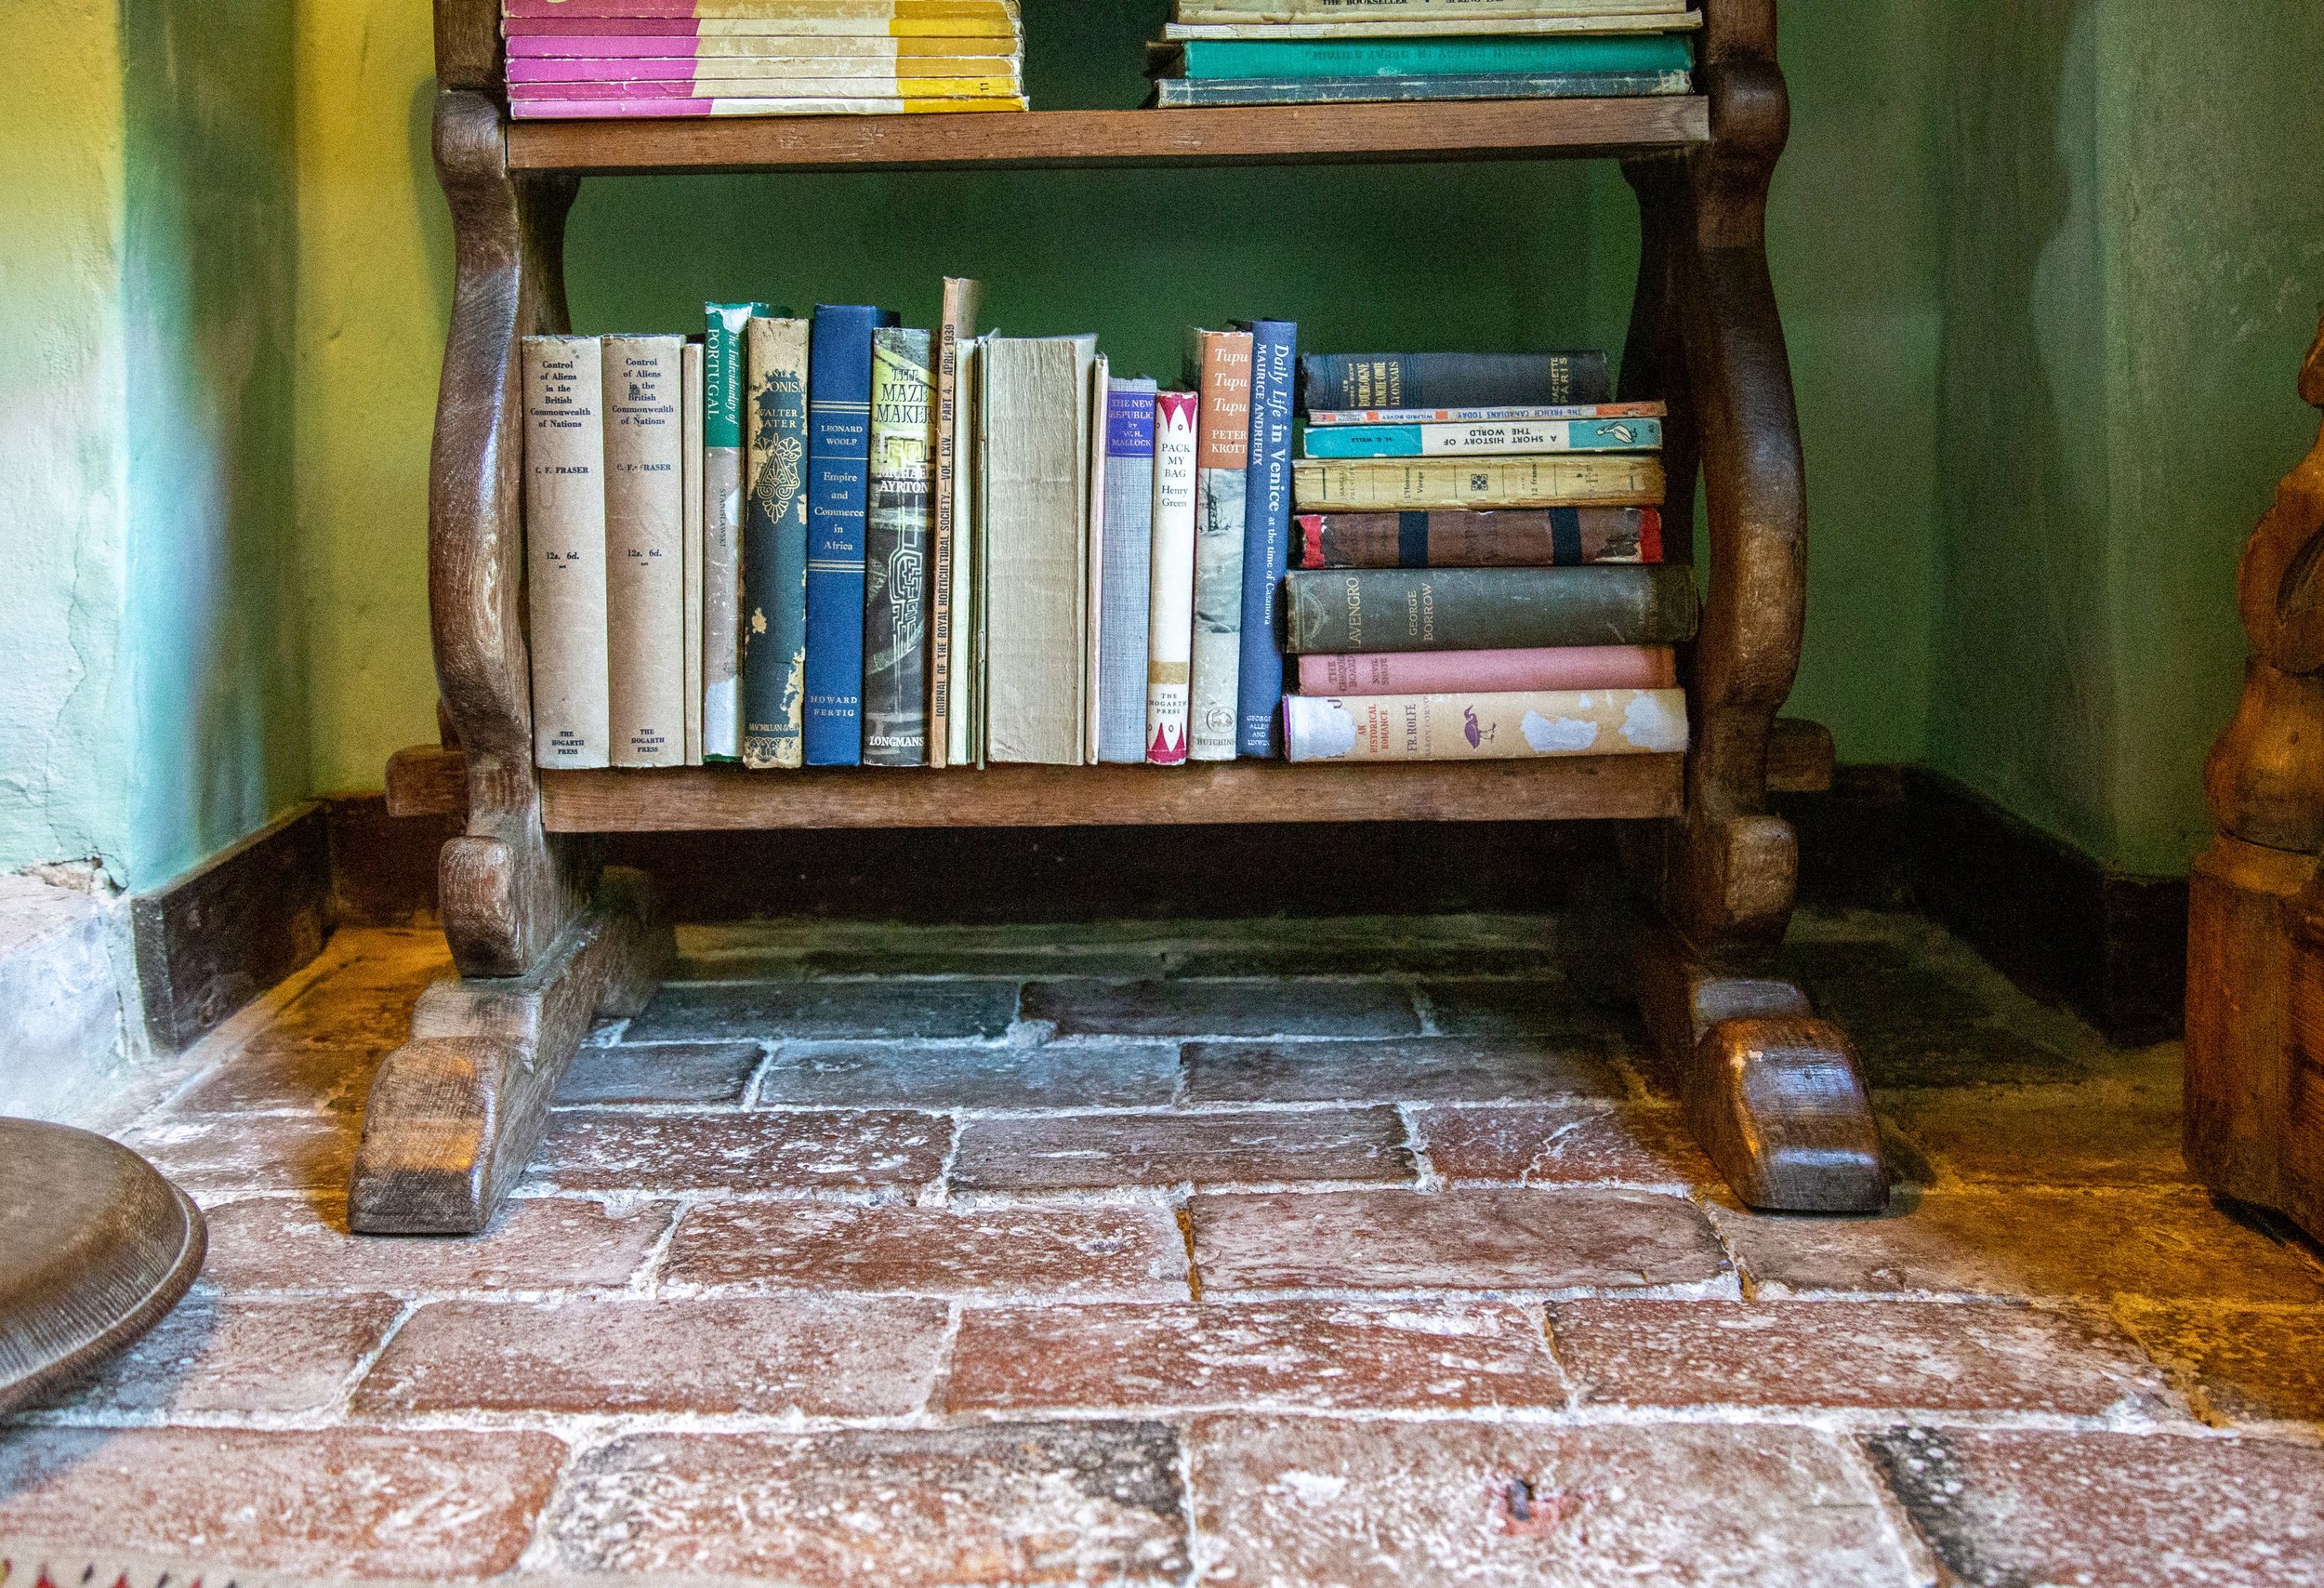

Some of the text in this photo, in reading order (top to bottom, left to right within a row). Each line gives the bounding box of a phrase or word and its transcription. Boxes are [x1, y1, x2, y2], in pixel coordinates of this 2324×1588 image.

[980, 83, 989, 91] 11
[944, 324, 955, 347] 1939
[626, 358, 657, 366] Control
[1214, 348, 1248, 366] Tupu
[542, 361, 574, 369] Control
[943, 351, 954, 376] APRIL
[552, 373, 577, 381] Aliens
[636, 369, 661, 378] Aliens
[707, 328, 720, 419] PORTUGAL
[726, 333, 740, 425] he Individuality of
[891, 368, 919, 381] THE
[1214, 372, 1248, 391] Tupu
[1356, 363, 1371, 407] BOURGOGNE
[1388, 361, 1400, 406] LYONNAIS
[1550, 357, 1559, 403] HACHETTE
[1559, 357, 1569, 404] PARIS
[628, 393, 656, 402] British
[880, 383, 929, 403] MAZE
[545, 396, 573, 404] British
[1112, 399, 1154, 408] THE NEW
[1252, 343, 1267, 466] MAURICE ANDRIEUX
[530, 407, 591, 417] Commonwealth
[612, 404, 674, 414] Commonwealth
[942, 397, 953, 422] PART
[1213, 397, 1247, 417] Tupu
[875, 404, 936, 424] MAKER
[1487, 409, 1529, 418] CANADIANS
[1535, 409, 1563, 417] FRENCH
[549, 419, 582, 428] Nations
[620, 417, 666, 426] of Nations
[763, 419, 797, 428] ATER
[821, 425, 863, 433] LEONARD
[1212, 430, 1247, 440] PETER
[826, 438, 858, 446] WOOLF
[942, 434, 953, 457] LXIV.
[1162, 443, 1191, 453] PACK
[1211, 443, 1247, 454] KROTT
[1168, 457, 1184, 466] MY
[555, 466, 589, 474] FRASER
[640, 464, 671, 472] RASER
[878, 468, 926, 479] MICHAE
[1165, 469, 1187, 478] BAG
[824, 471, 858, 483] Empire
[878, 480, 929, 494] AYRTON
[1264, 343, 1289, 625] Daily Life in Venice at the time of Casanova
[831, 491, 849, 500] and
[1162, 484, 1188, 496] Henry
[1162, 497, 1187, 508] Green
[814, 507, 865, 517] Commerce
[834, 524, 843, 533] in
[824, 541, 853, 550] Africa
[566, 551, 580, 560] 6d.
[649, 549, 662, 557] 6d.
[938, 535, 950, 606] HORTICULTURAL
[1347, 577, 1362, 648] LAVENGRO
[1408, 590, 1417, 636] GEORGE
[1422, 582, 1433, 641] BORROW
[937, 610, 948, 639] ROYAL
[937, 642, 947, 659] THE
[937, 663, 946, 675] OF
[1328, 661, 1337, 682] THE
[811, 695, 858, 704] HOWARD
[936, 679, 946, 717] JOURNAL
[813, 708, 854, 717] FERTIG
[1358, 725, 1366, 735] AN
[1368, 704, 1377, 753] HISTORICAL
[869, 736, 925, 747] LONGMANS
